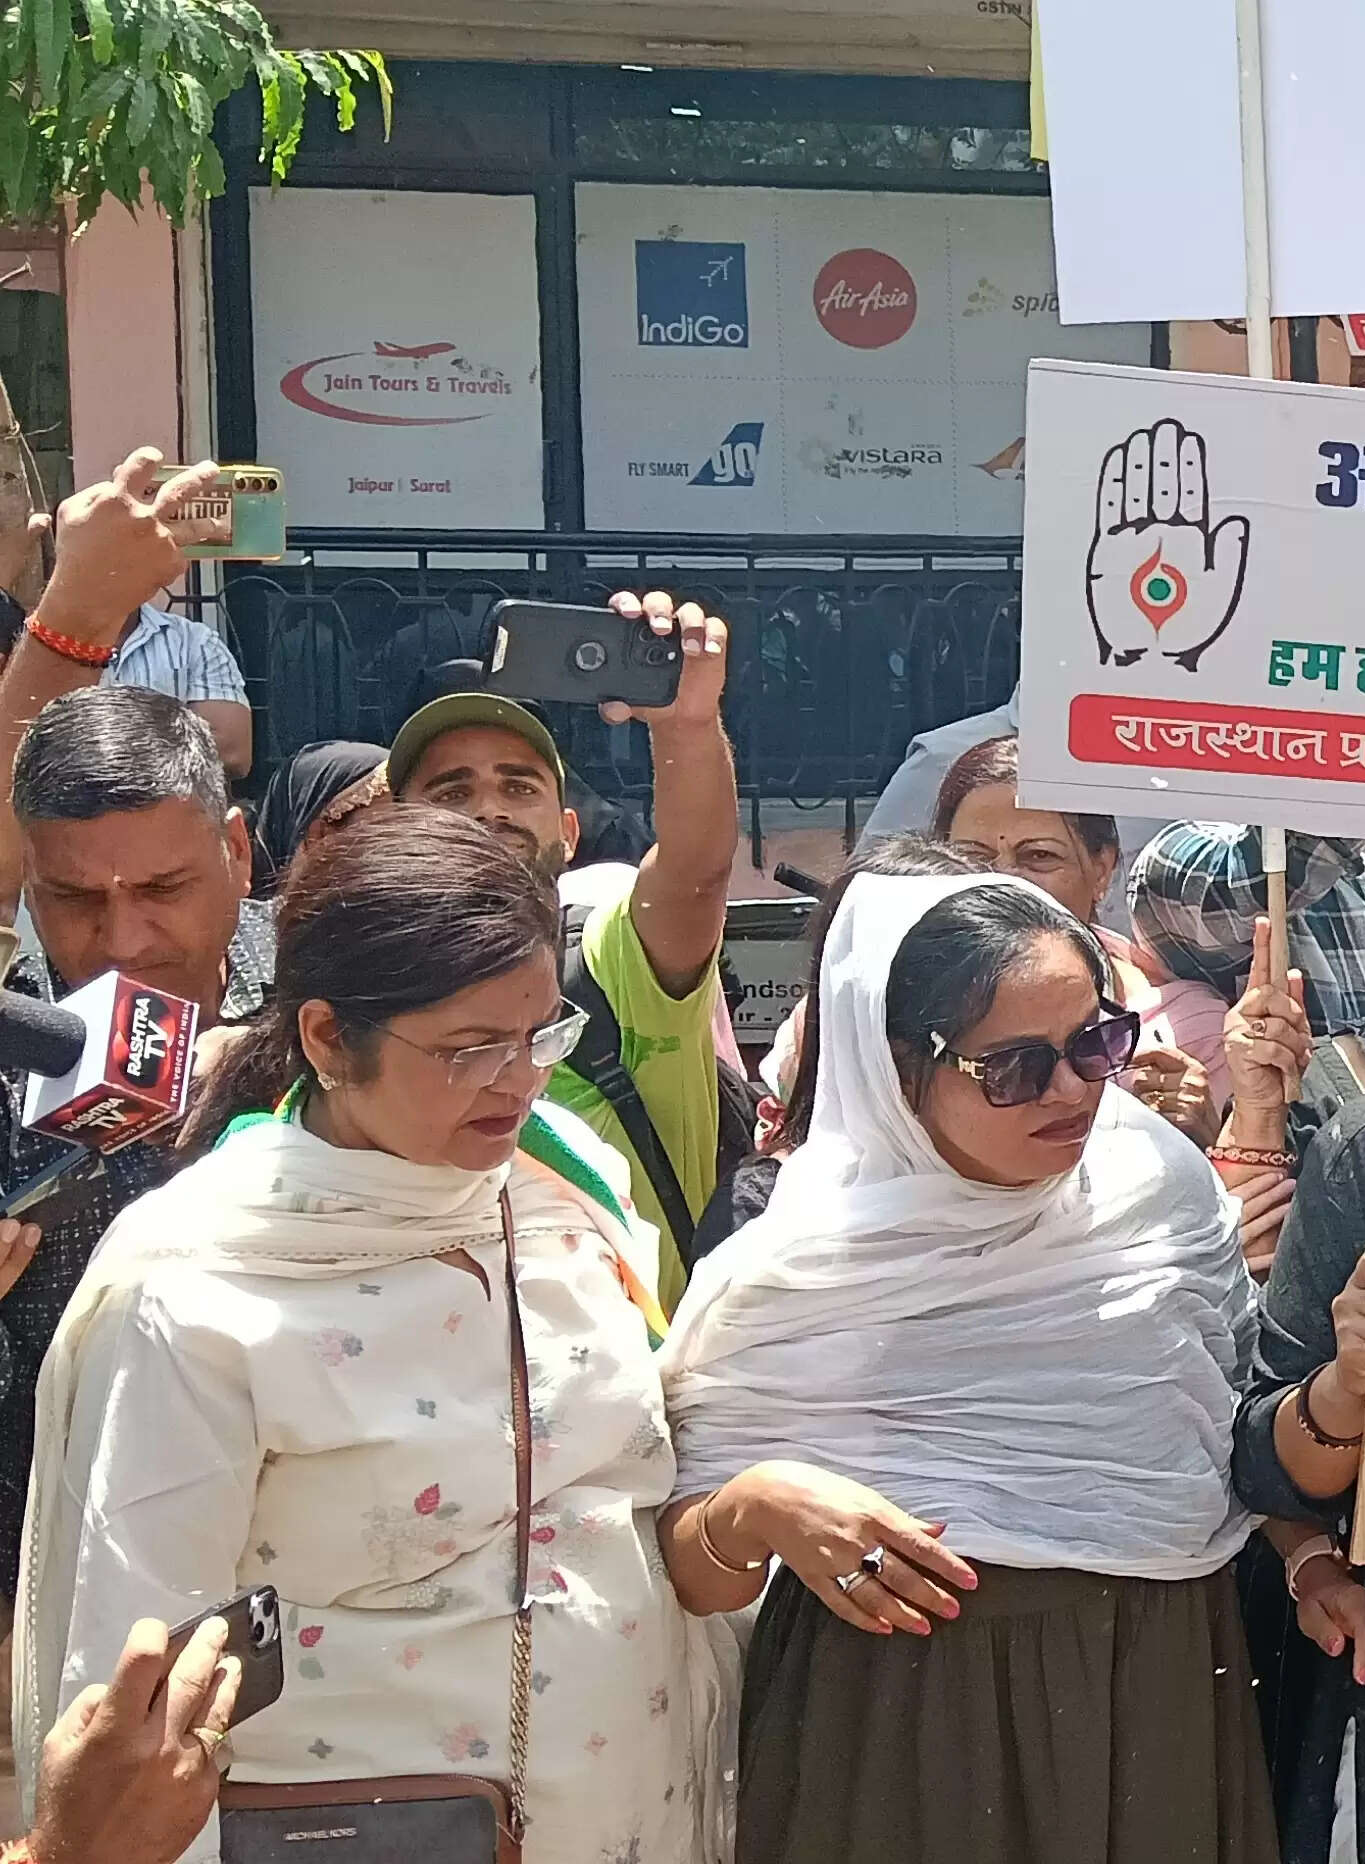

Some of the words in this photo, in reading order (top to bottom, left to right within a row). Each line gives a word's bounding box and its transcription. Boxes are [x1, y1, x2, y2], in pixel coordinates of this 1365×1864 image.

[641, 314, 745, 344] IndiGo
[324, 374, 362, 393] Jain
[368, 374, 419, 393] Tours
[426, 377, 440, 392] &
[447, 377, 512, 395] Travels
[629, 462, 645, 477] FLY
[649, 462, 689, 477] SMART
[348, 477, 393, 494] Jaipur
[1269, 640, 1345, 690] हम
[1112, 714, 1328, 765] राजस्थान
[127, 998, 151, 1077] RASHTRA
[144, 1020, 169, 1059] TV
[61, 1097, 125, 1132] RASHTRA
[88, 1109, 128, 1130] TV
